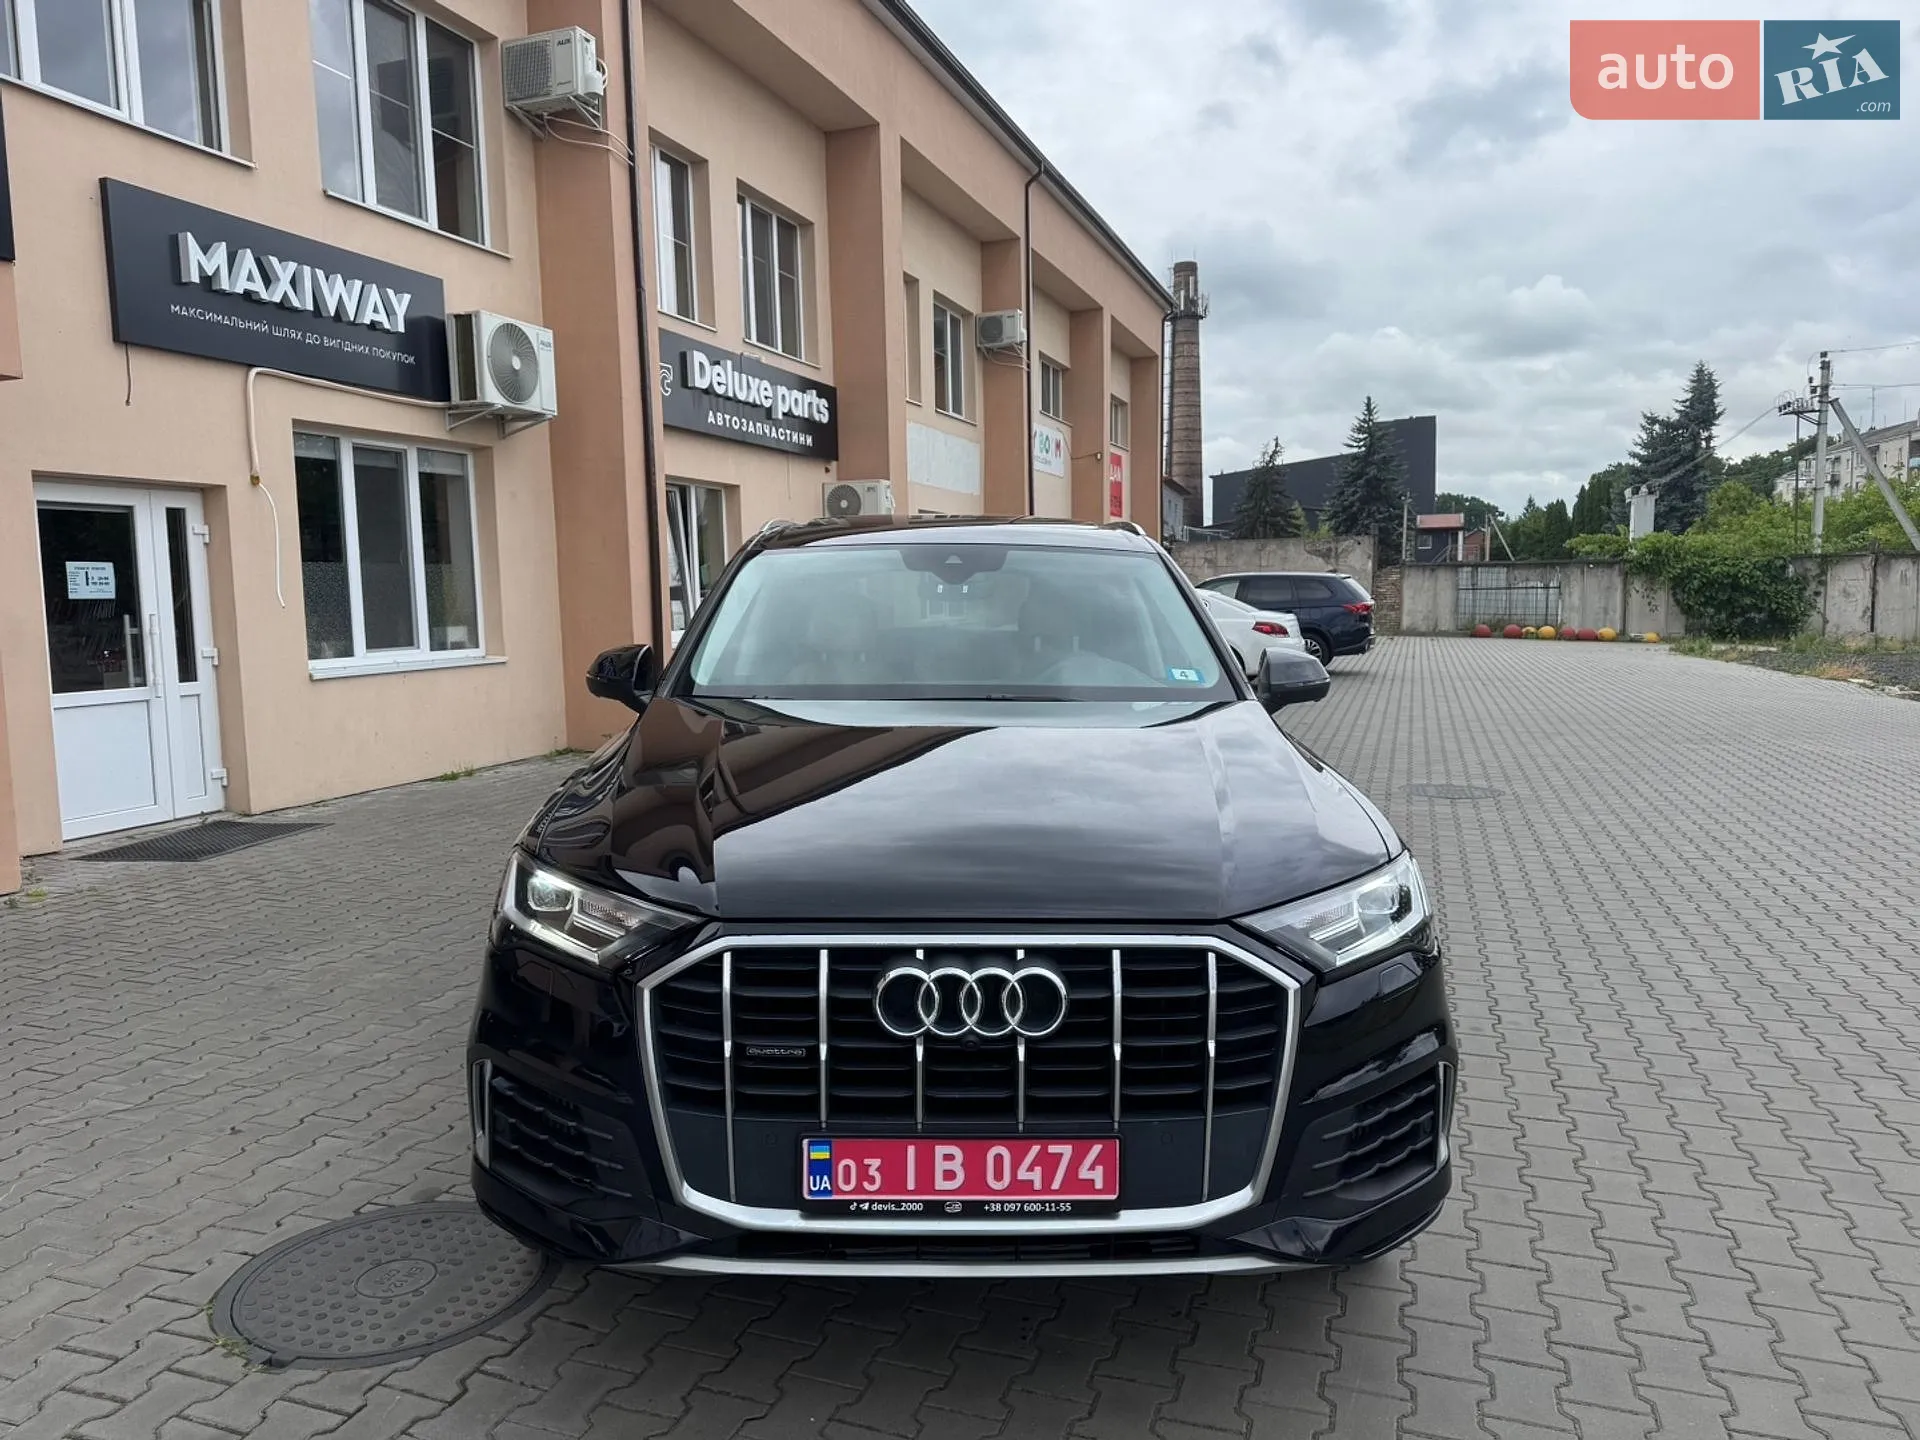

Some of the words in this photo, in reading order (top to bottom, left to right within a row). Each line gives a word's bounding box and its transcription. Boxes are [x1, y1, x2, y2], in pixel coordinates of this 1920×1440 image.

[177, 231, 412, 333] MAXIWAY
[169, 303, 270, 334] МАКСИМАЛЬНИЙ
[271, 324, 303, 341] ШЛЯХ
[305, 332, 321, 345] ДО
[323, 336, 370, 355] ВИГІДНИХ
[371, 346, 416, 365] ПОКУПОК
[687, 349, 774, 409] Deluxe
[771, 384, 830, 425] parts
[707, 409, 814, 448] АВТОЗАПЧАСТИНИ
[809, 1174, 832, 1191] UA
[837, 1158, 882, 1192] 03
[985, 1144, 1104, 1191] 0474
[983, 1202, 1001, 1212] +38
[1003, 1202, 1021, 1212] 097
[1023, 1202, 1072, 1212] 600-11-55
